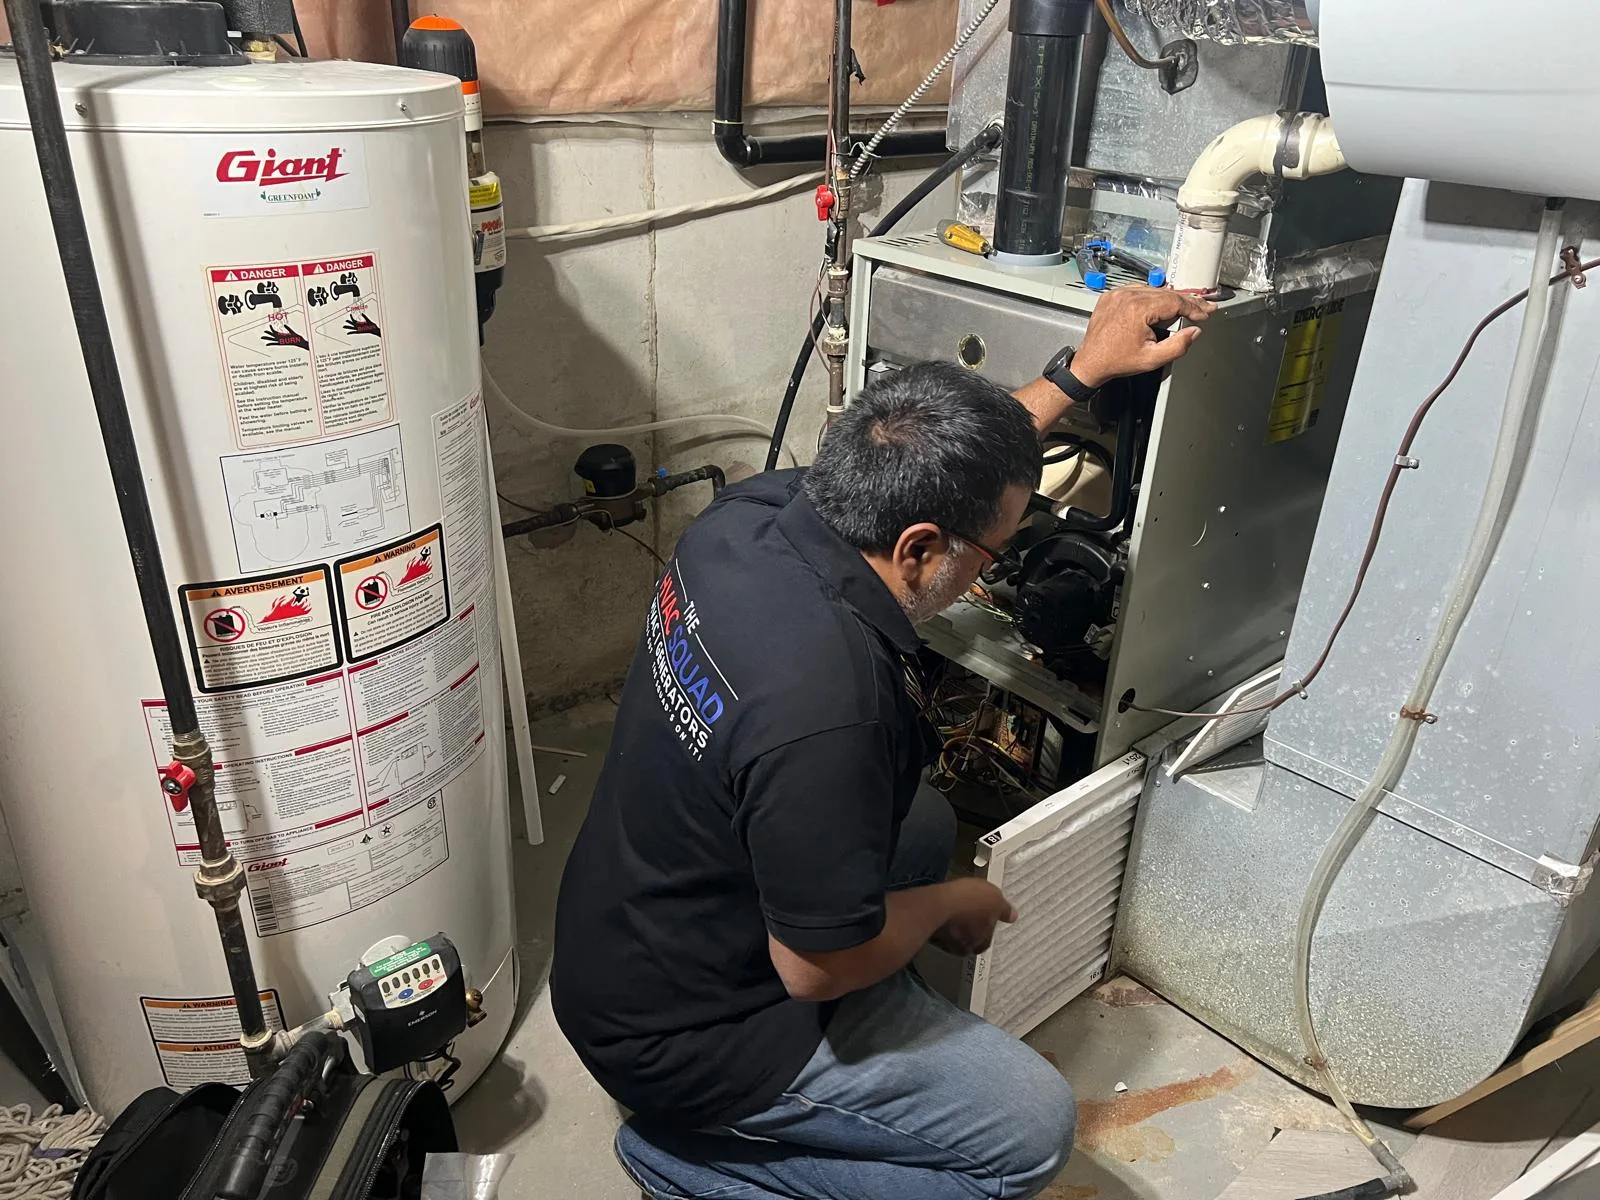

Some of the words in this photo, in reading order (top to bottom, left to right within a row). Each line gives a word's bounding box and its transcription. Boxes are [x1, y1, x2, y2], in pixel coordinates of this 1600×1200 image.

[216, 147, 348, 186] Giant
[268, 192, 316, 202] GREENFOAM
[240, 268, 286, 280] DANGER
[326, 260, 364, 272] DANGER
[268, 312, 288, 322] HOT
[279, 334, 300, 345] BURN
[383, 542, 416, 560] WARNING
[224, 576, 304, 596] AVERTISSEMENT
[660, 569, 680, 636] HVAC
[683, 600, 700, 635] THE
[668, 624, 724, 725] SQUAD
[656, 641, 708, 748] GENERATORS
[655, 679, 675, 722] SQUAD'S
[675, 726, 687, 741] ON
[248, 858, 289, 872] Giant
[203, 1044, 243, 1052] ATTENTIO
